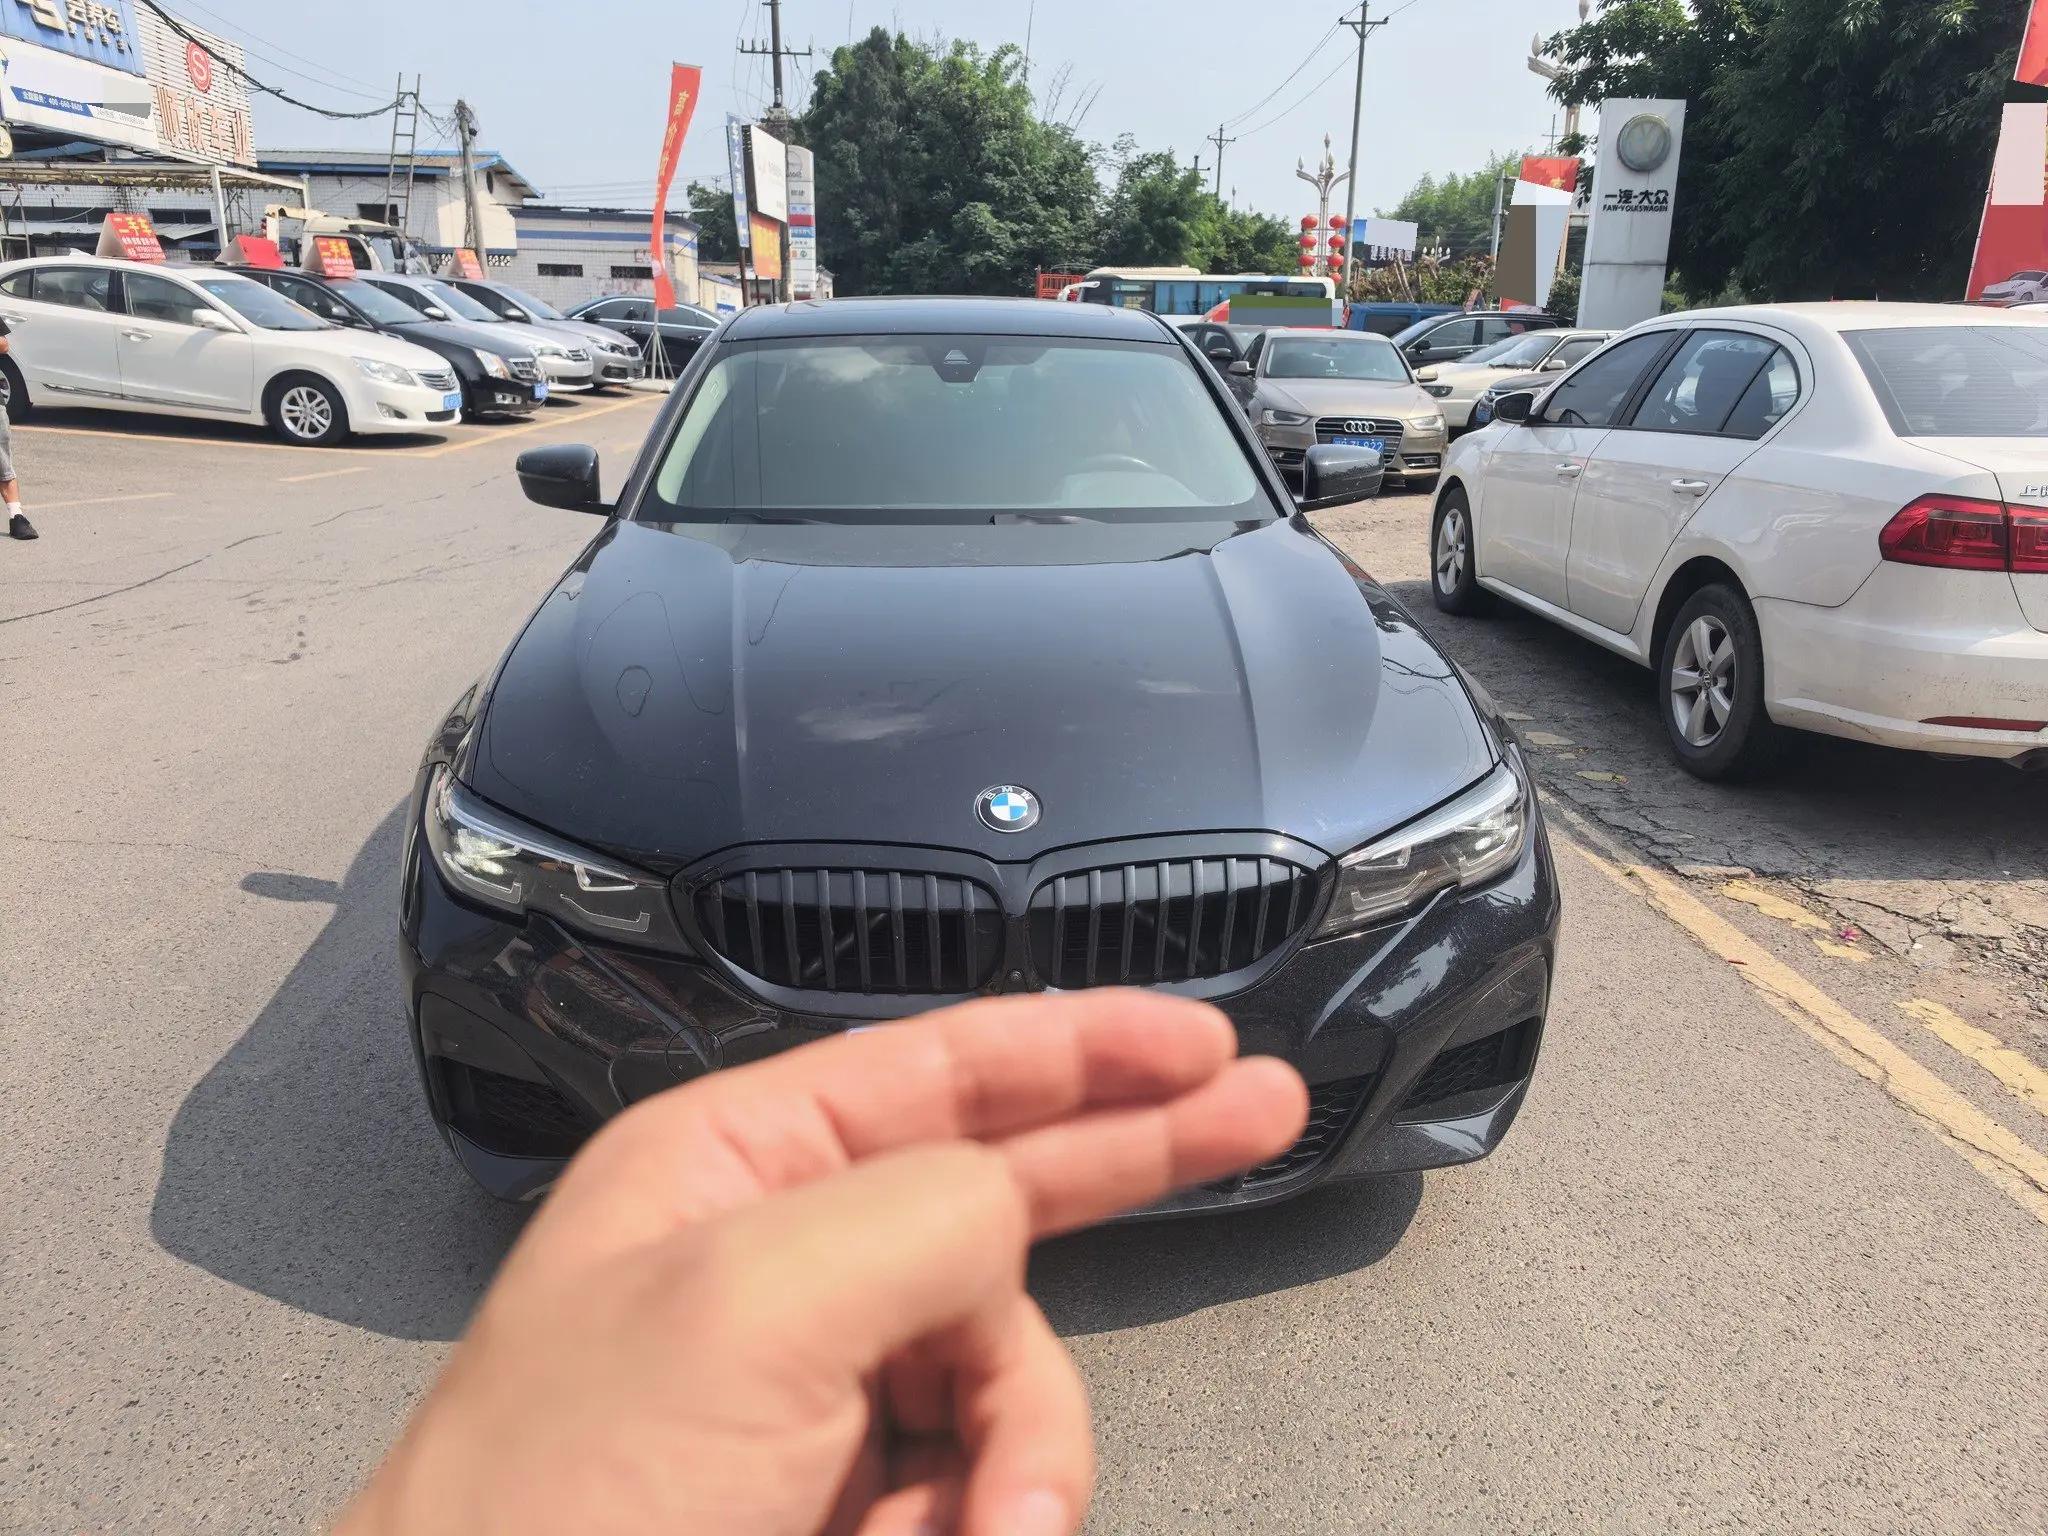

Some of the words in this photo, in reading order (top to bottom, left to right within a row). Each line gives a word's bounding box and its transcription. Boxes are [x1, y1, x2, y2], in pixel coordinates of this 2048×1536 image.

[1602, 204, 1669, 212] FAW-VOLKSWAGEN
[112, 216, 153, 237] 二手车
